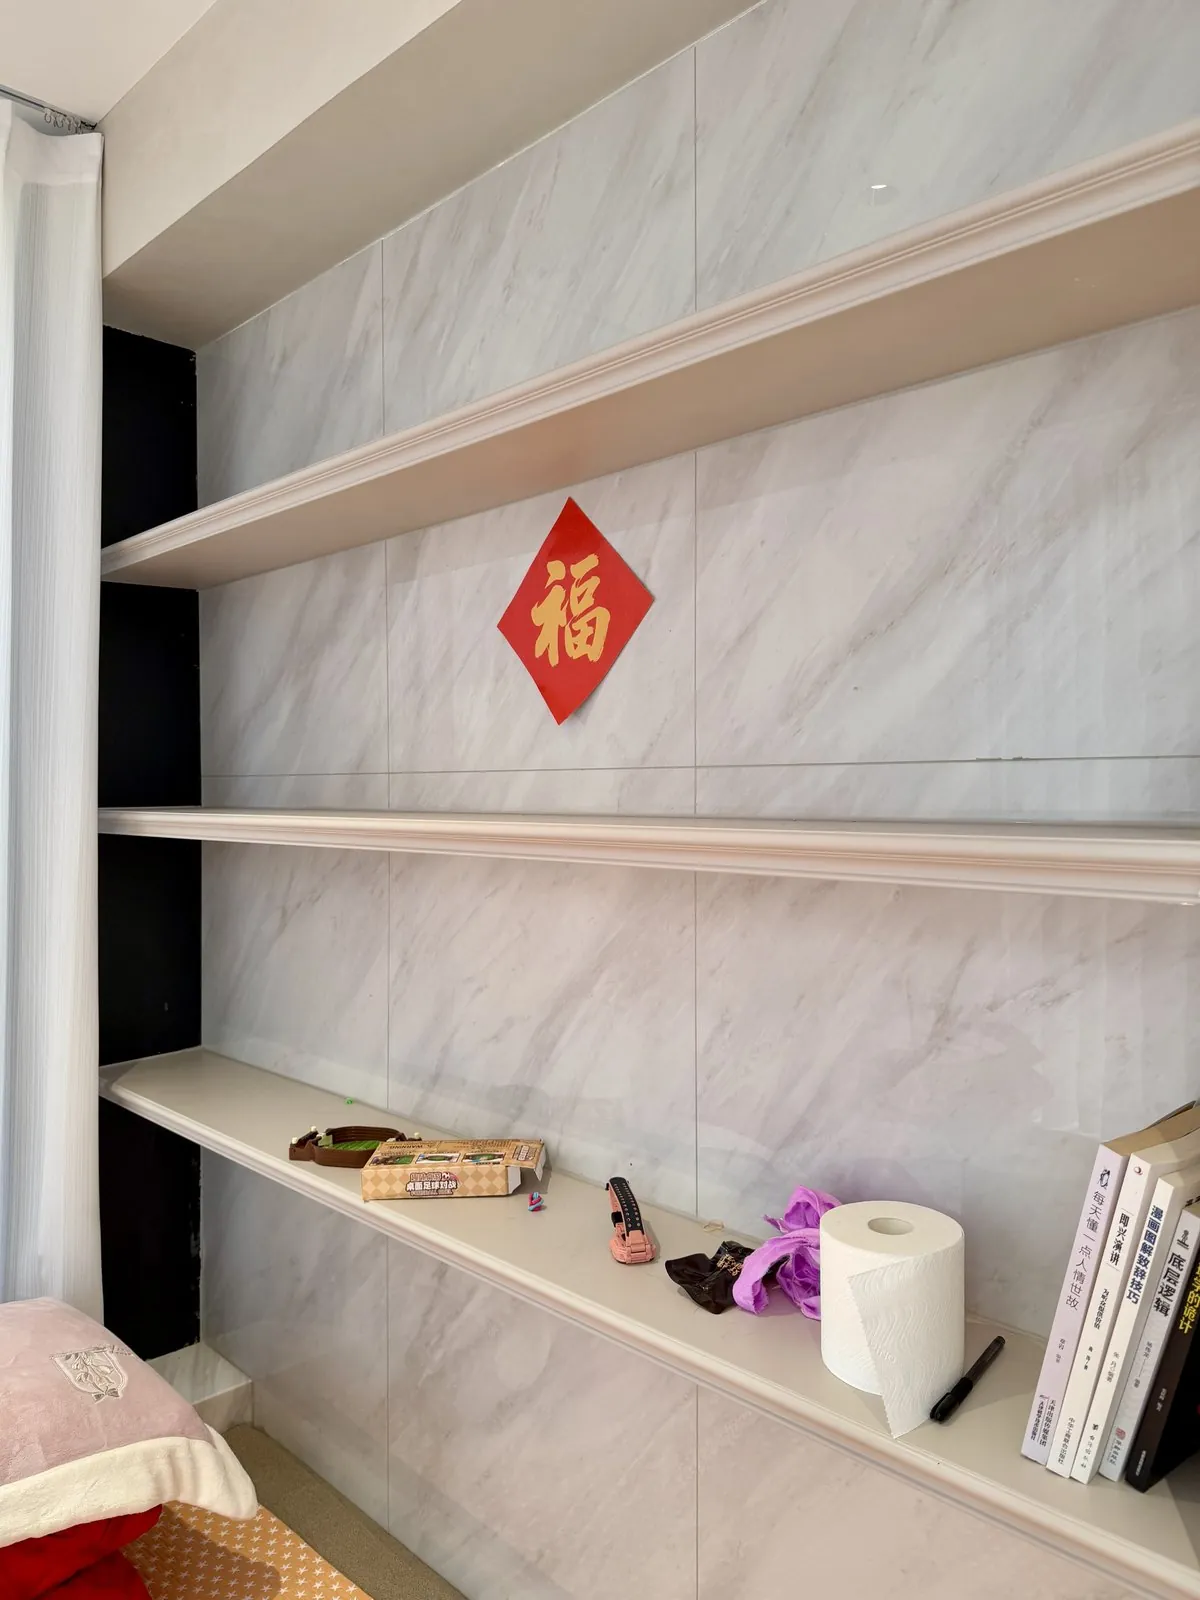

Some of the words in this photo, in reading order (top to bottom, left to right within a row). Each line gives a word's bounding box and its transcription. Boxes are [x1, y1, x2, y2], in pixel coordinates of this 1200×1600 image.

[531, 553, 611, 668] 福
[406, 1180, 457, 1191] 桌面足球对战
[1065, 1191, 1106, 1311] 每天懂一点人情世故
[1108, 1212, 1130, 1267] 即兴演讲
[1126, 1205, 1164, 1305] 漫画图解致辞技巧
[1153, 1252, 1187, 1317] 底层逻辑
